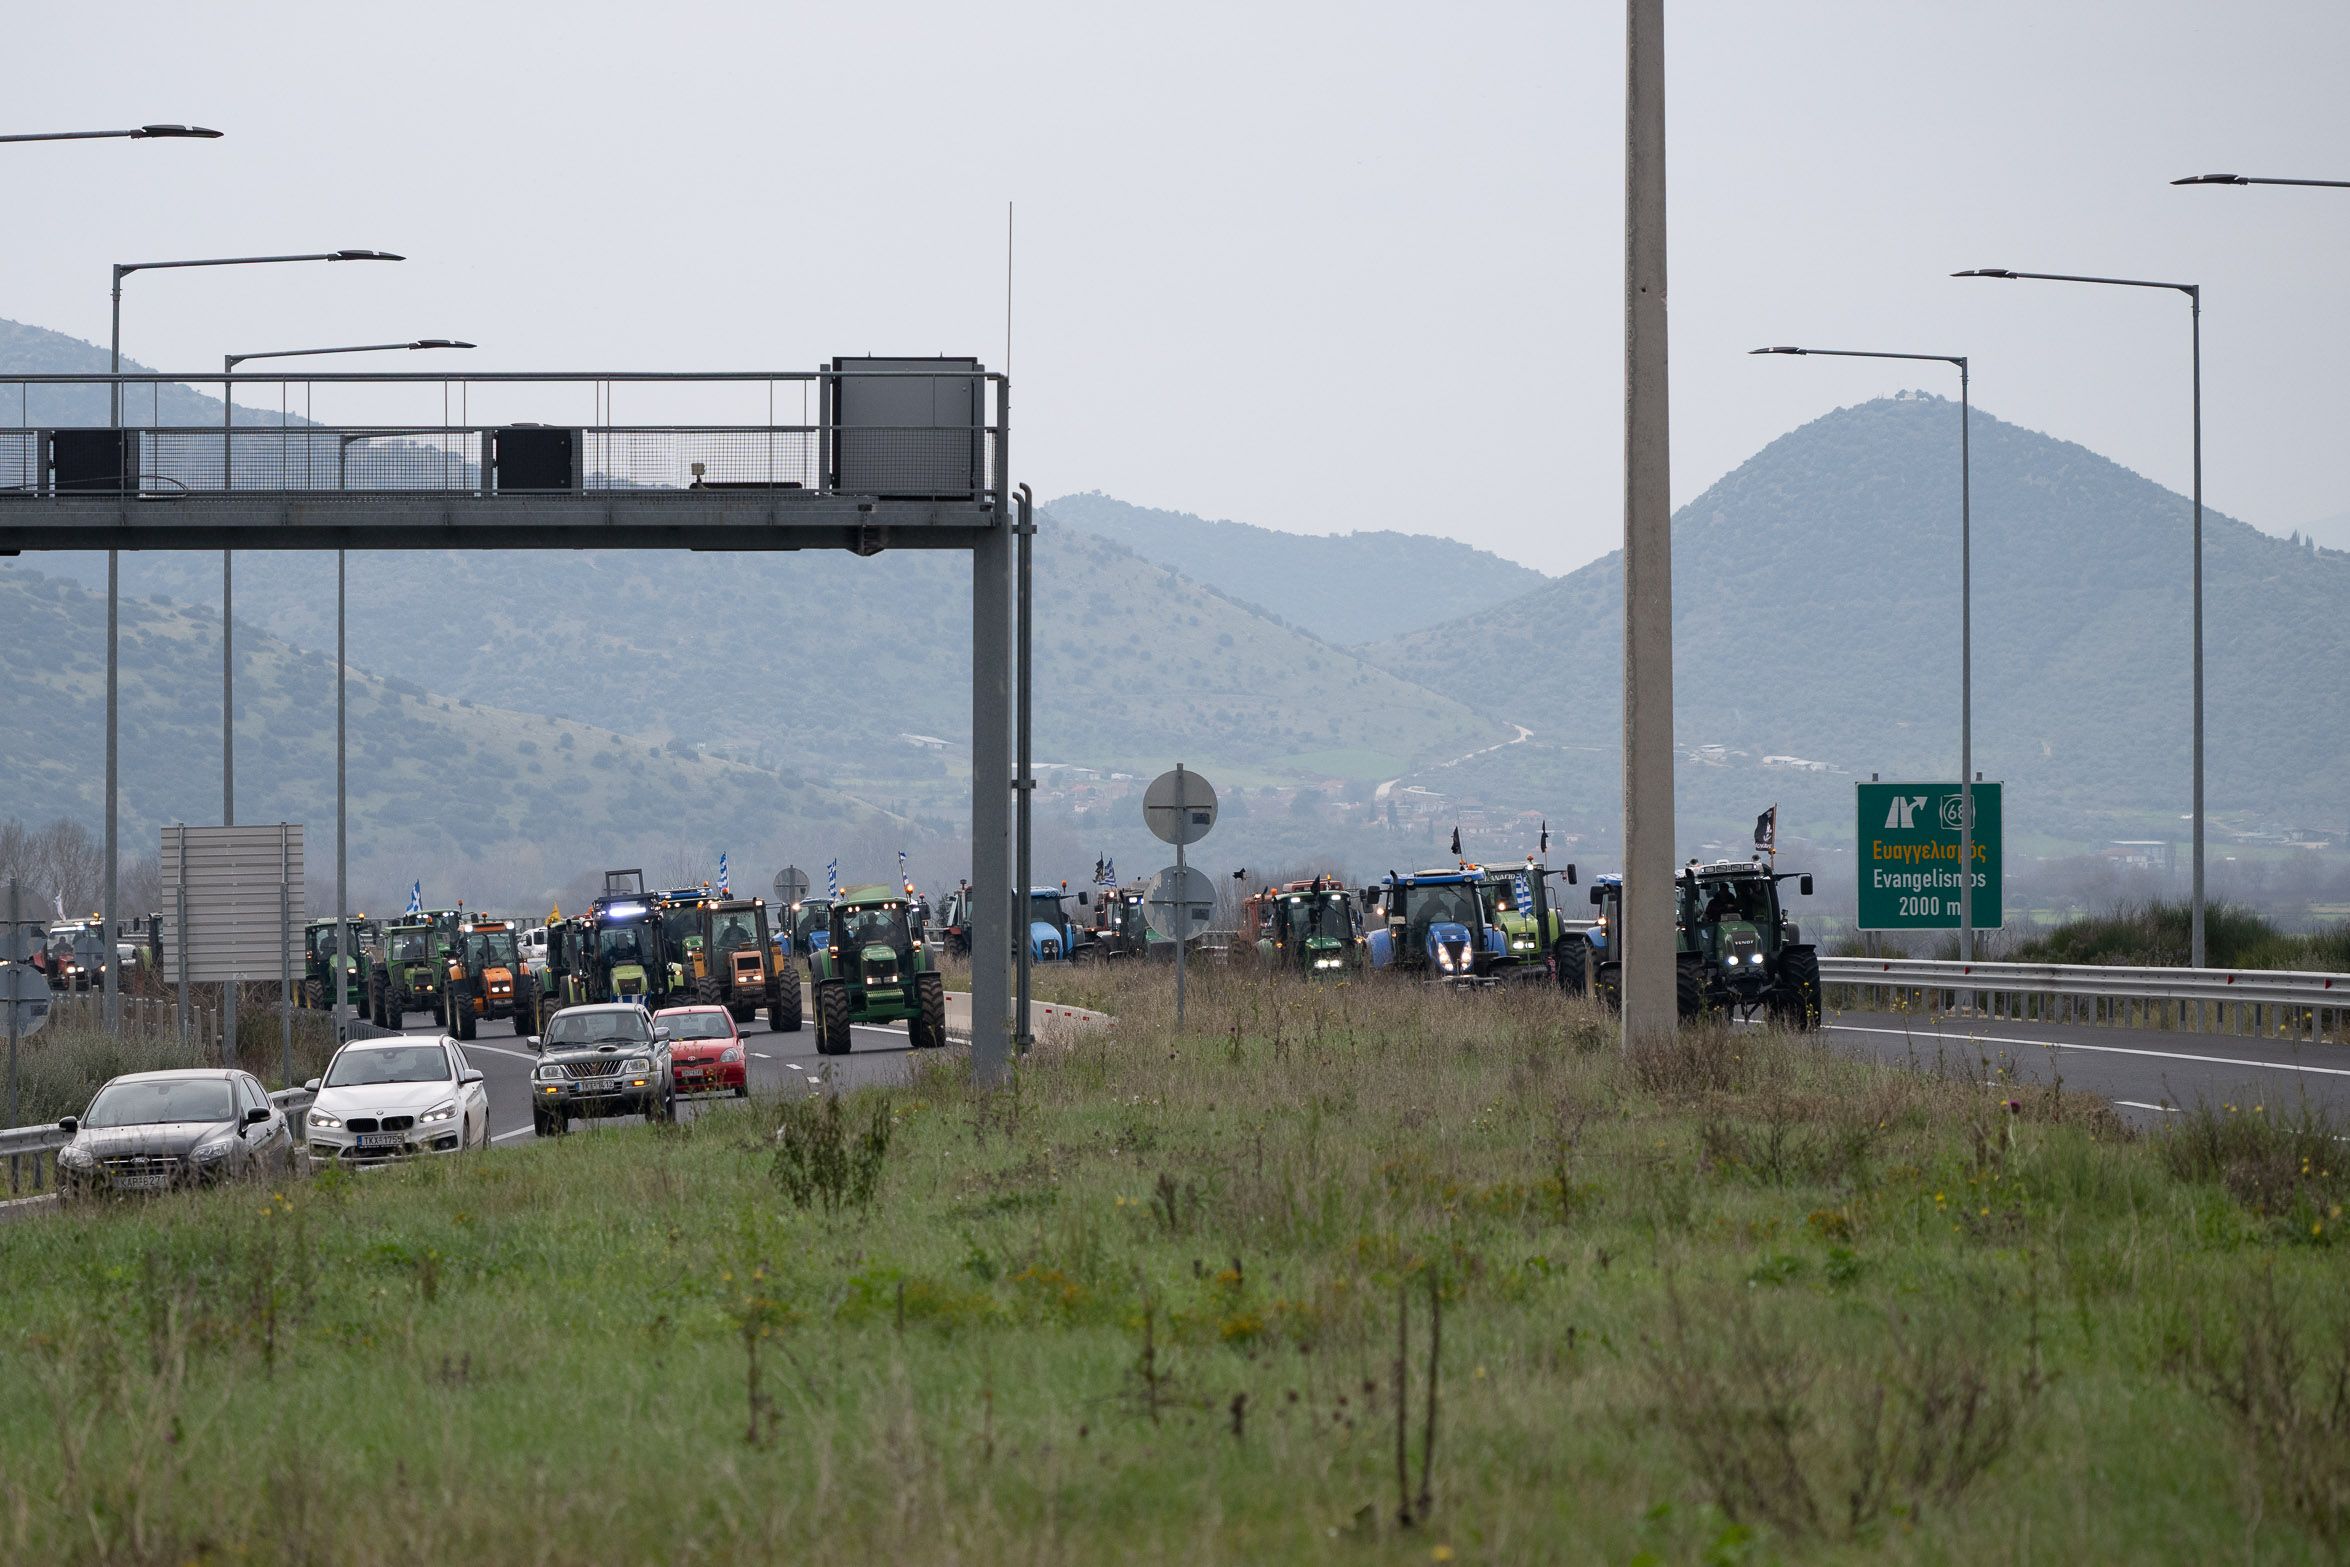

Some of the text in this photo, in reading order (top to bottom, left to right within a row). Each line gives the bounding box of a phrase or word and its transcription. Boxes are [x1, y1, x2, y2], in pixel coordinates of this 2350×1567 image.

[1948, 804, 1963, 820] 68
[1873, 868, 1987, 893] Evangelismos
[1899, 896, 1961, 916] 2000 m
